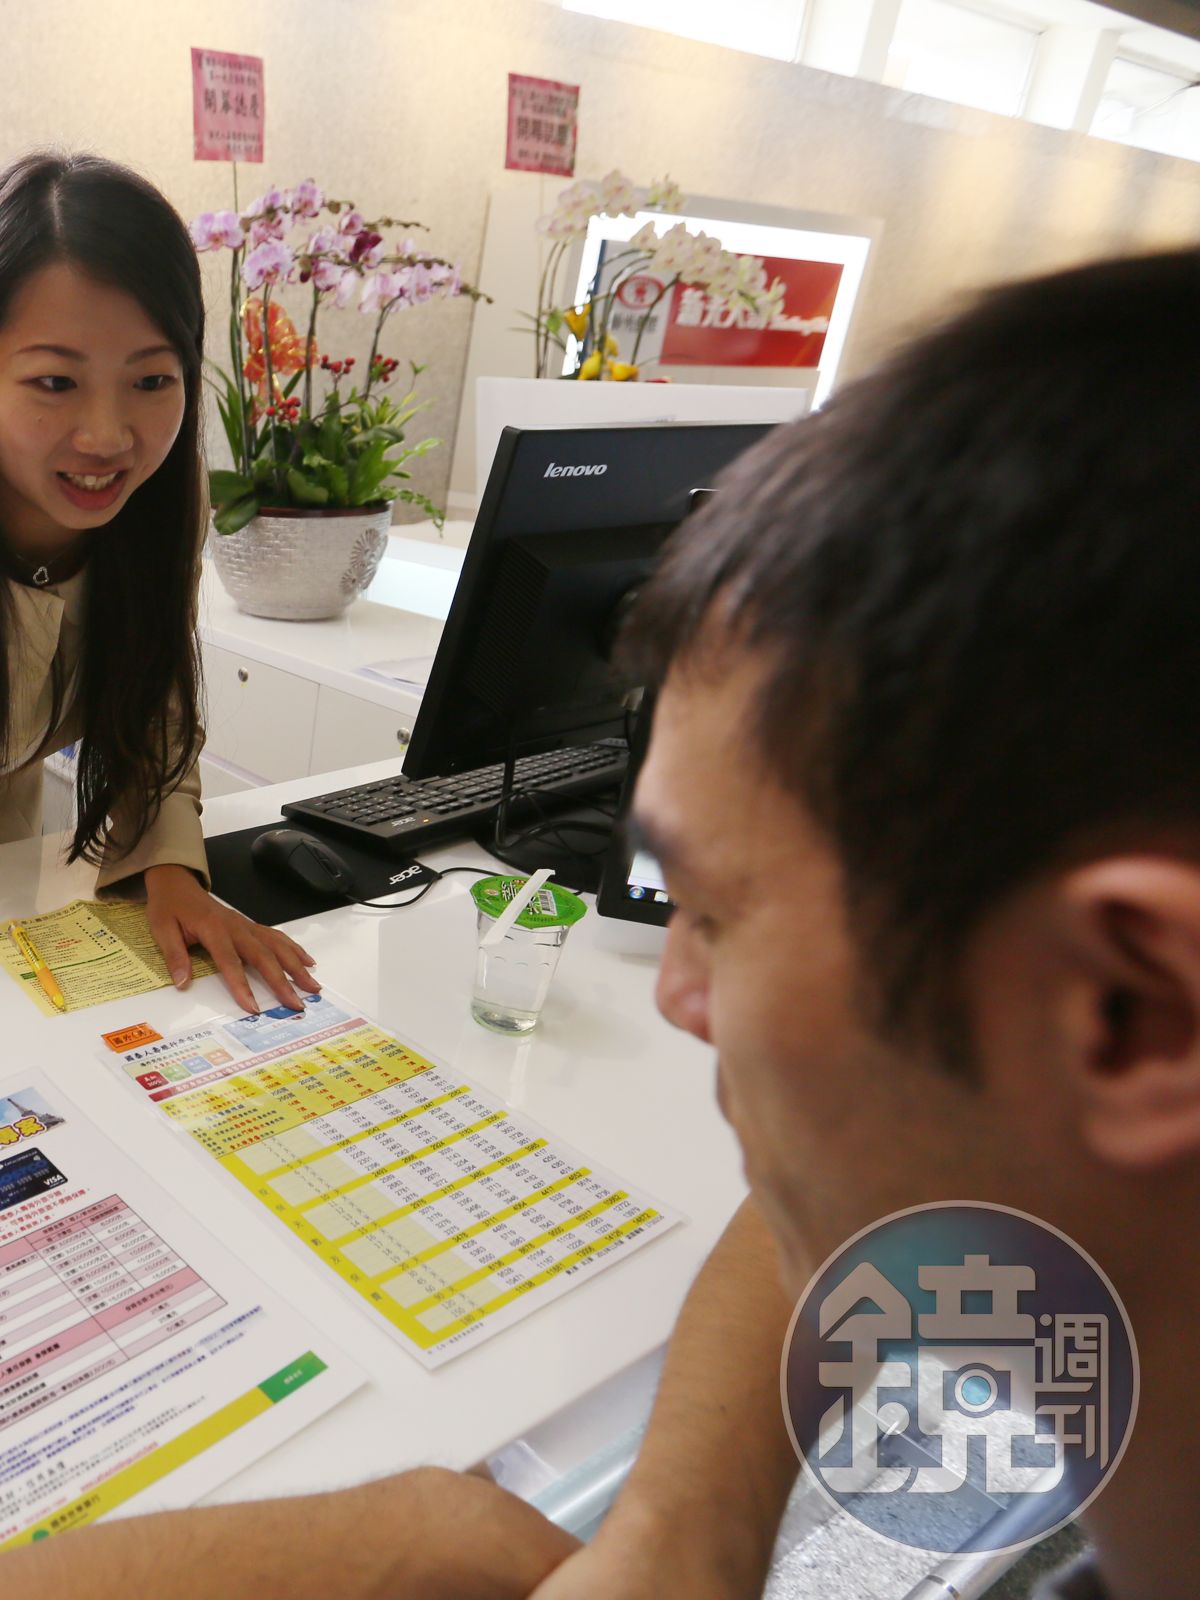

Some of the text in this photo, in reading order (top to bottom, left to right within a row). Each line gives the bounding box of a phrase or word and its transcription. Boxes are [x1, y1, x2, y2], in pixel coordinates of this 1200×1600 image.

[542, 461, 608, 479] lenovo
[389, 865, 423, 885] acer
[43, 1174, 65, 1187] VISA
